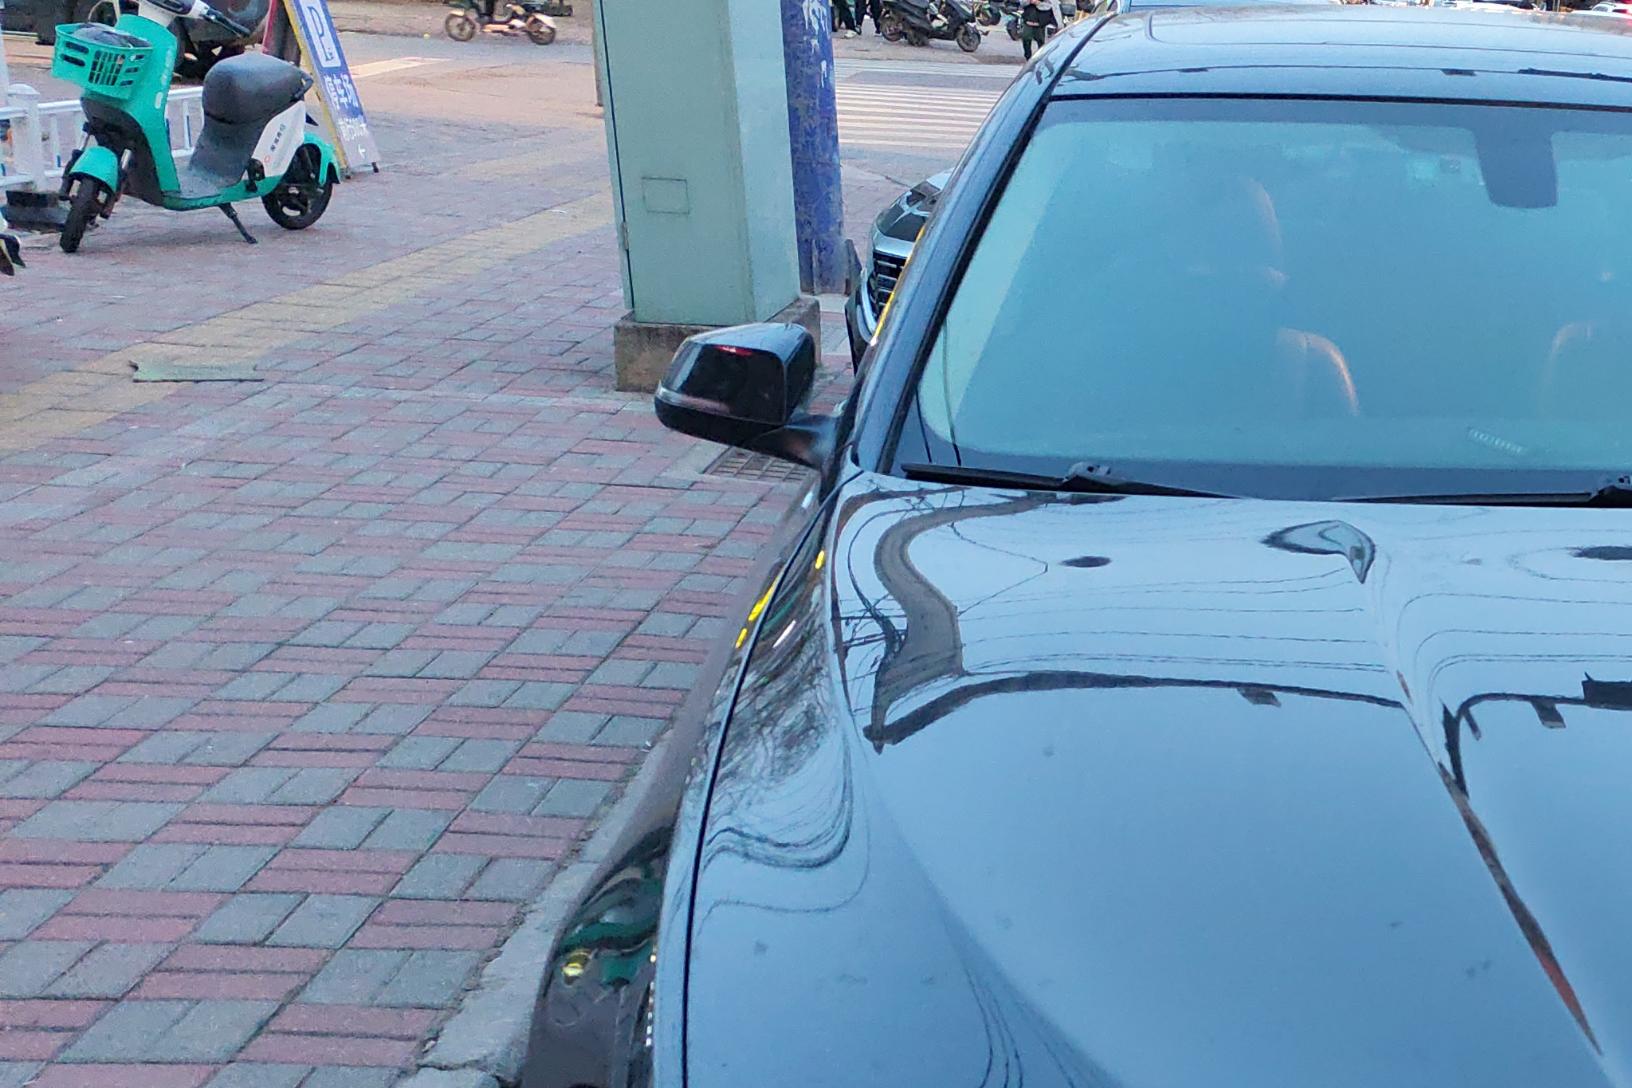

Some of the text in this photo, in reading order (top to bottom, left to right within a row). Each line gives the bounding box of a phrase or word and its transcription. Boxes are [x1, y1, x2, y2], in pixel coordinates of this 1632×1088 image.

[308, 6, 334, 61] P
[324, 73, 359, 110] 停车场
